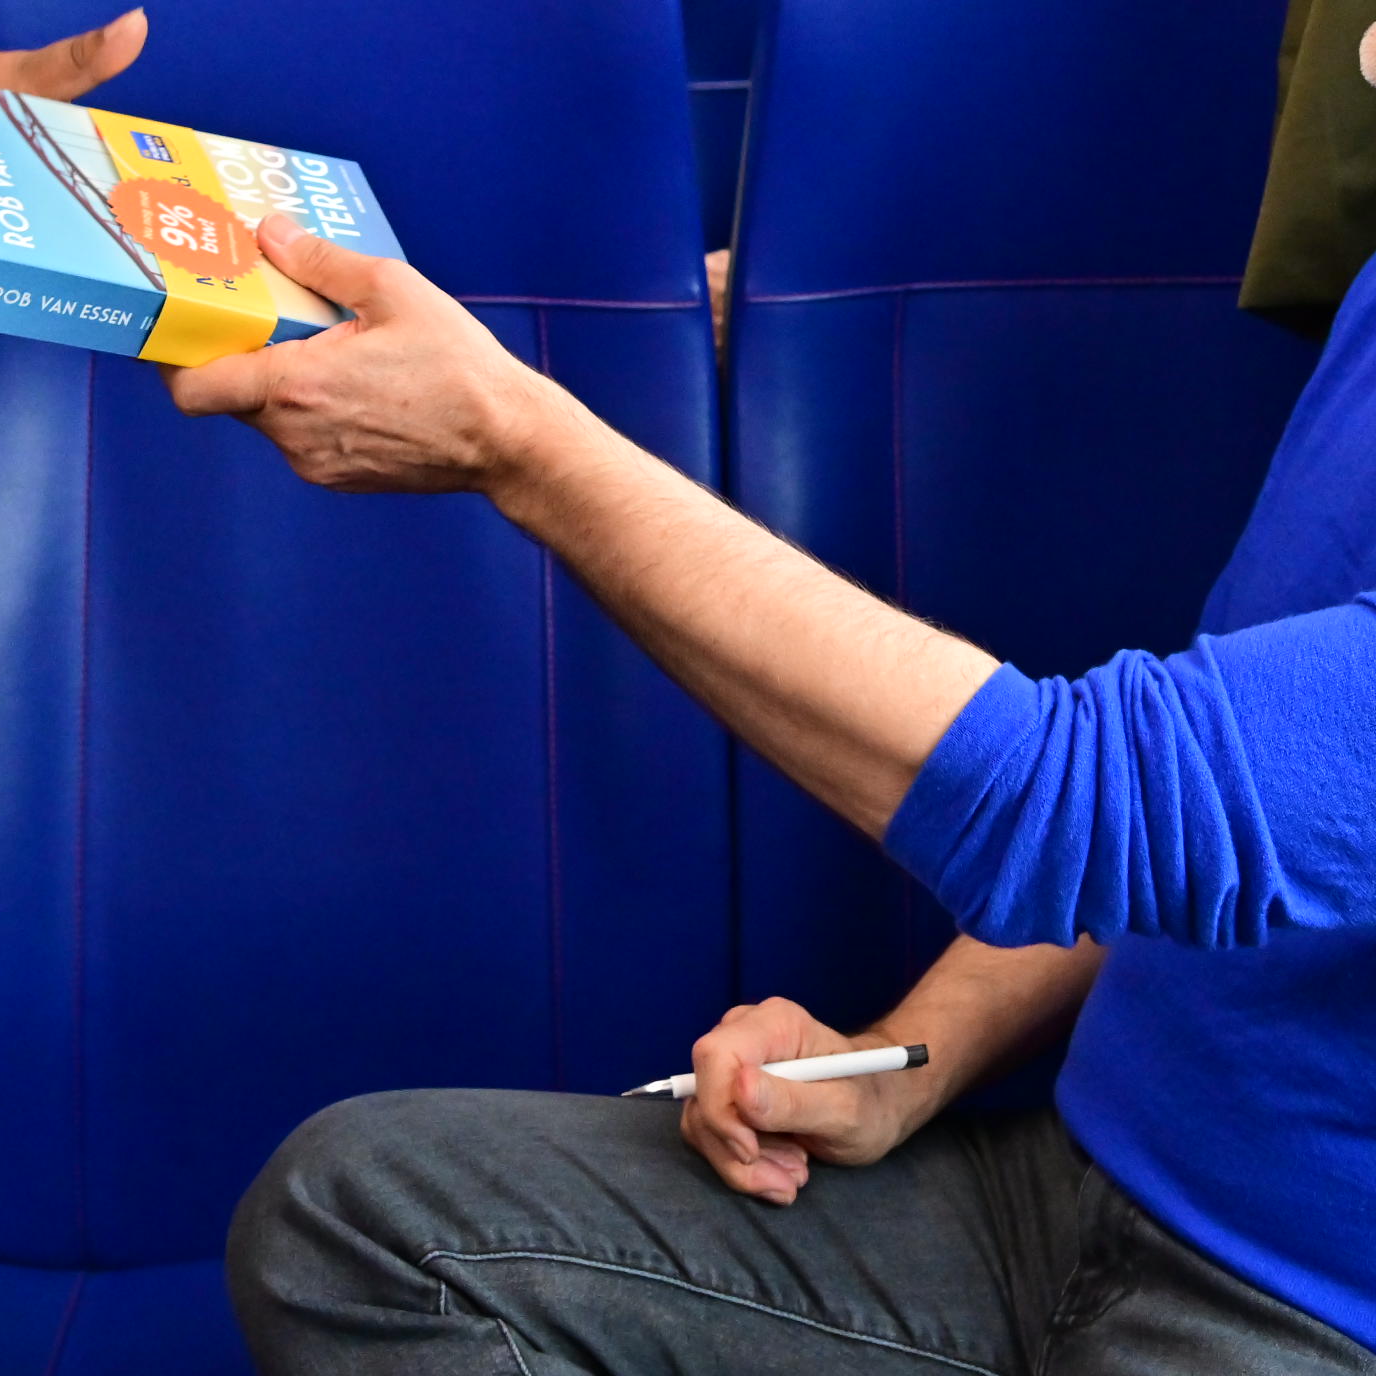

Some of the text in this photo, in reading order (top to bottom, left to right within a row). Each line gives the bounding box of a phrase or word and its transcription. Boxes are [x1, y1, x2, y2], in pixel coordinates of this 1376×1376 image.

[206, 138, 265, 204] KOM
[249, 147, 310, 214] NOG
[291, 155, 361, 238] TERUG
[157, 202, 198, 251] 9%
[197, 217, 219, 254] btw!
[41, 296, 77, 316] VAN
[80, 304, 133, 326] ESSEN
